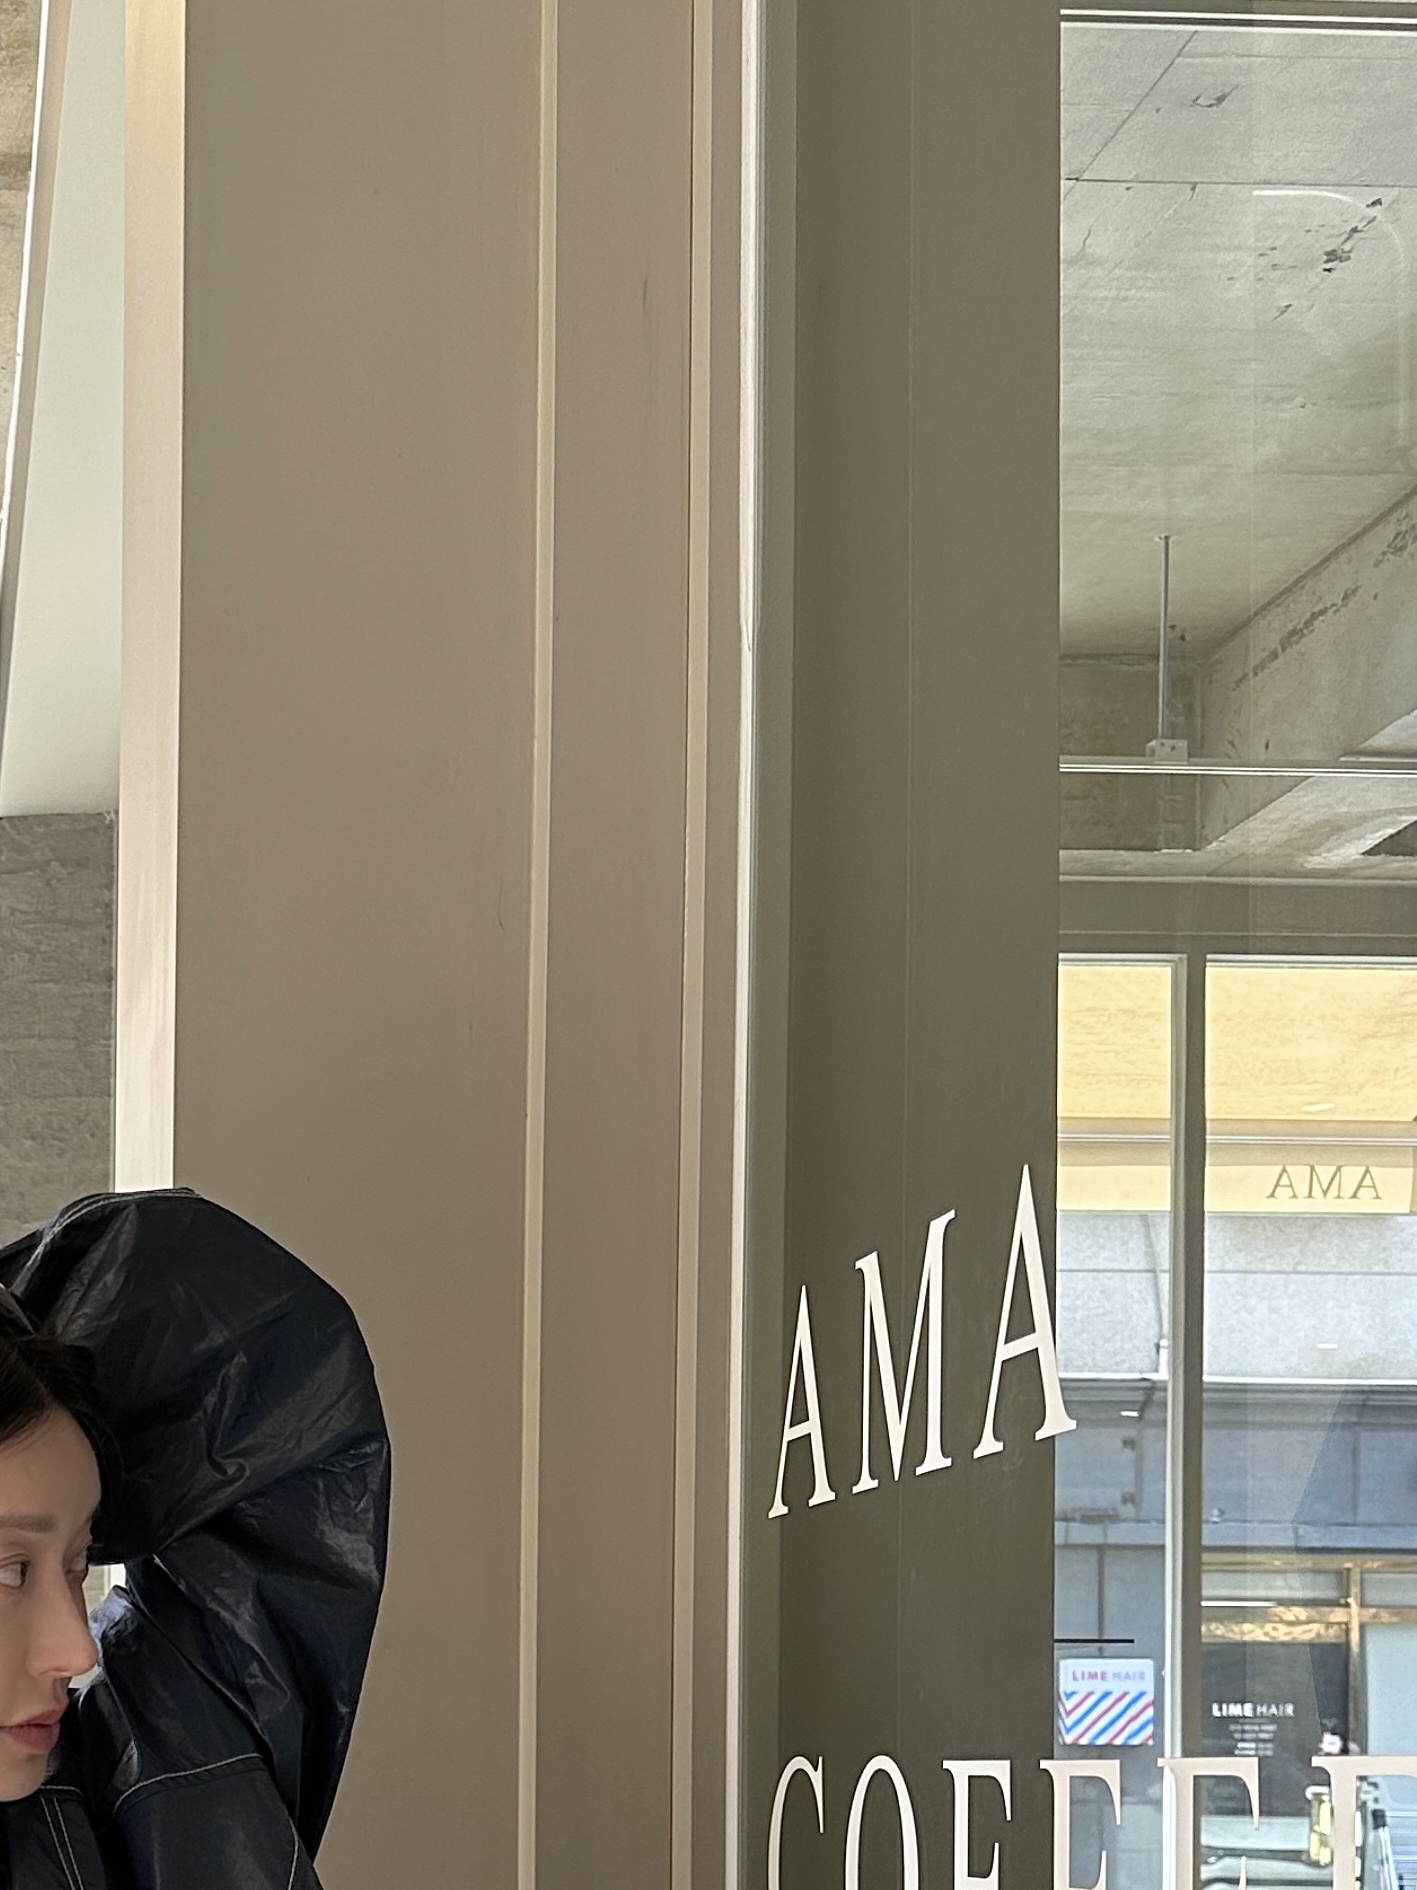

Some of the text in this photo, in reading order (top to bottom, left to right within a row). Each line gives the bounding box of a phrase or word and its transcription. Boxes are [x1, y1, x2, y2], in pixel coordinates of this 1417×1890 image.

[768, 1164, 1076, 1519] AMA
[1072, 1670, 1145, 1682] LIME HAIR
[1212, 1702, 1295, 1717] LIME HAIR
